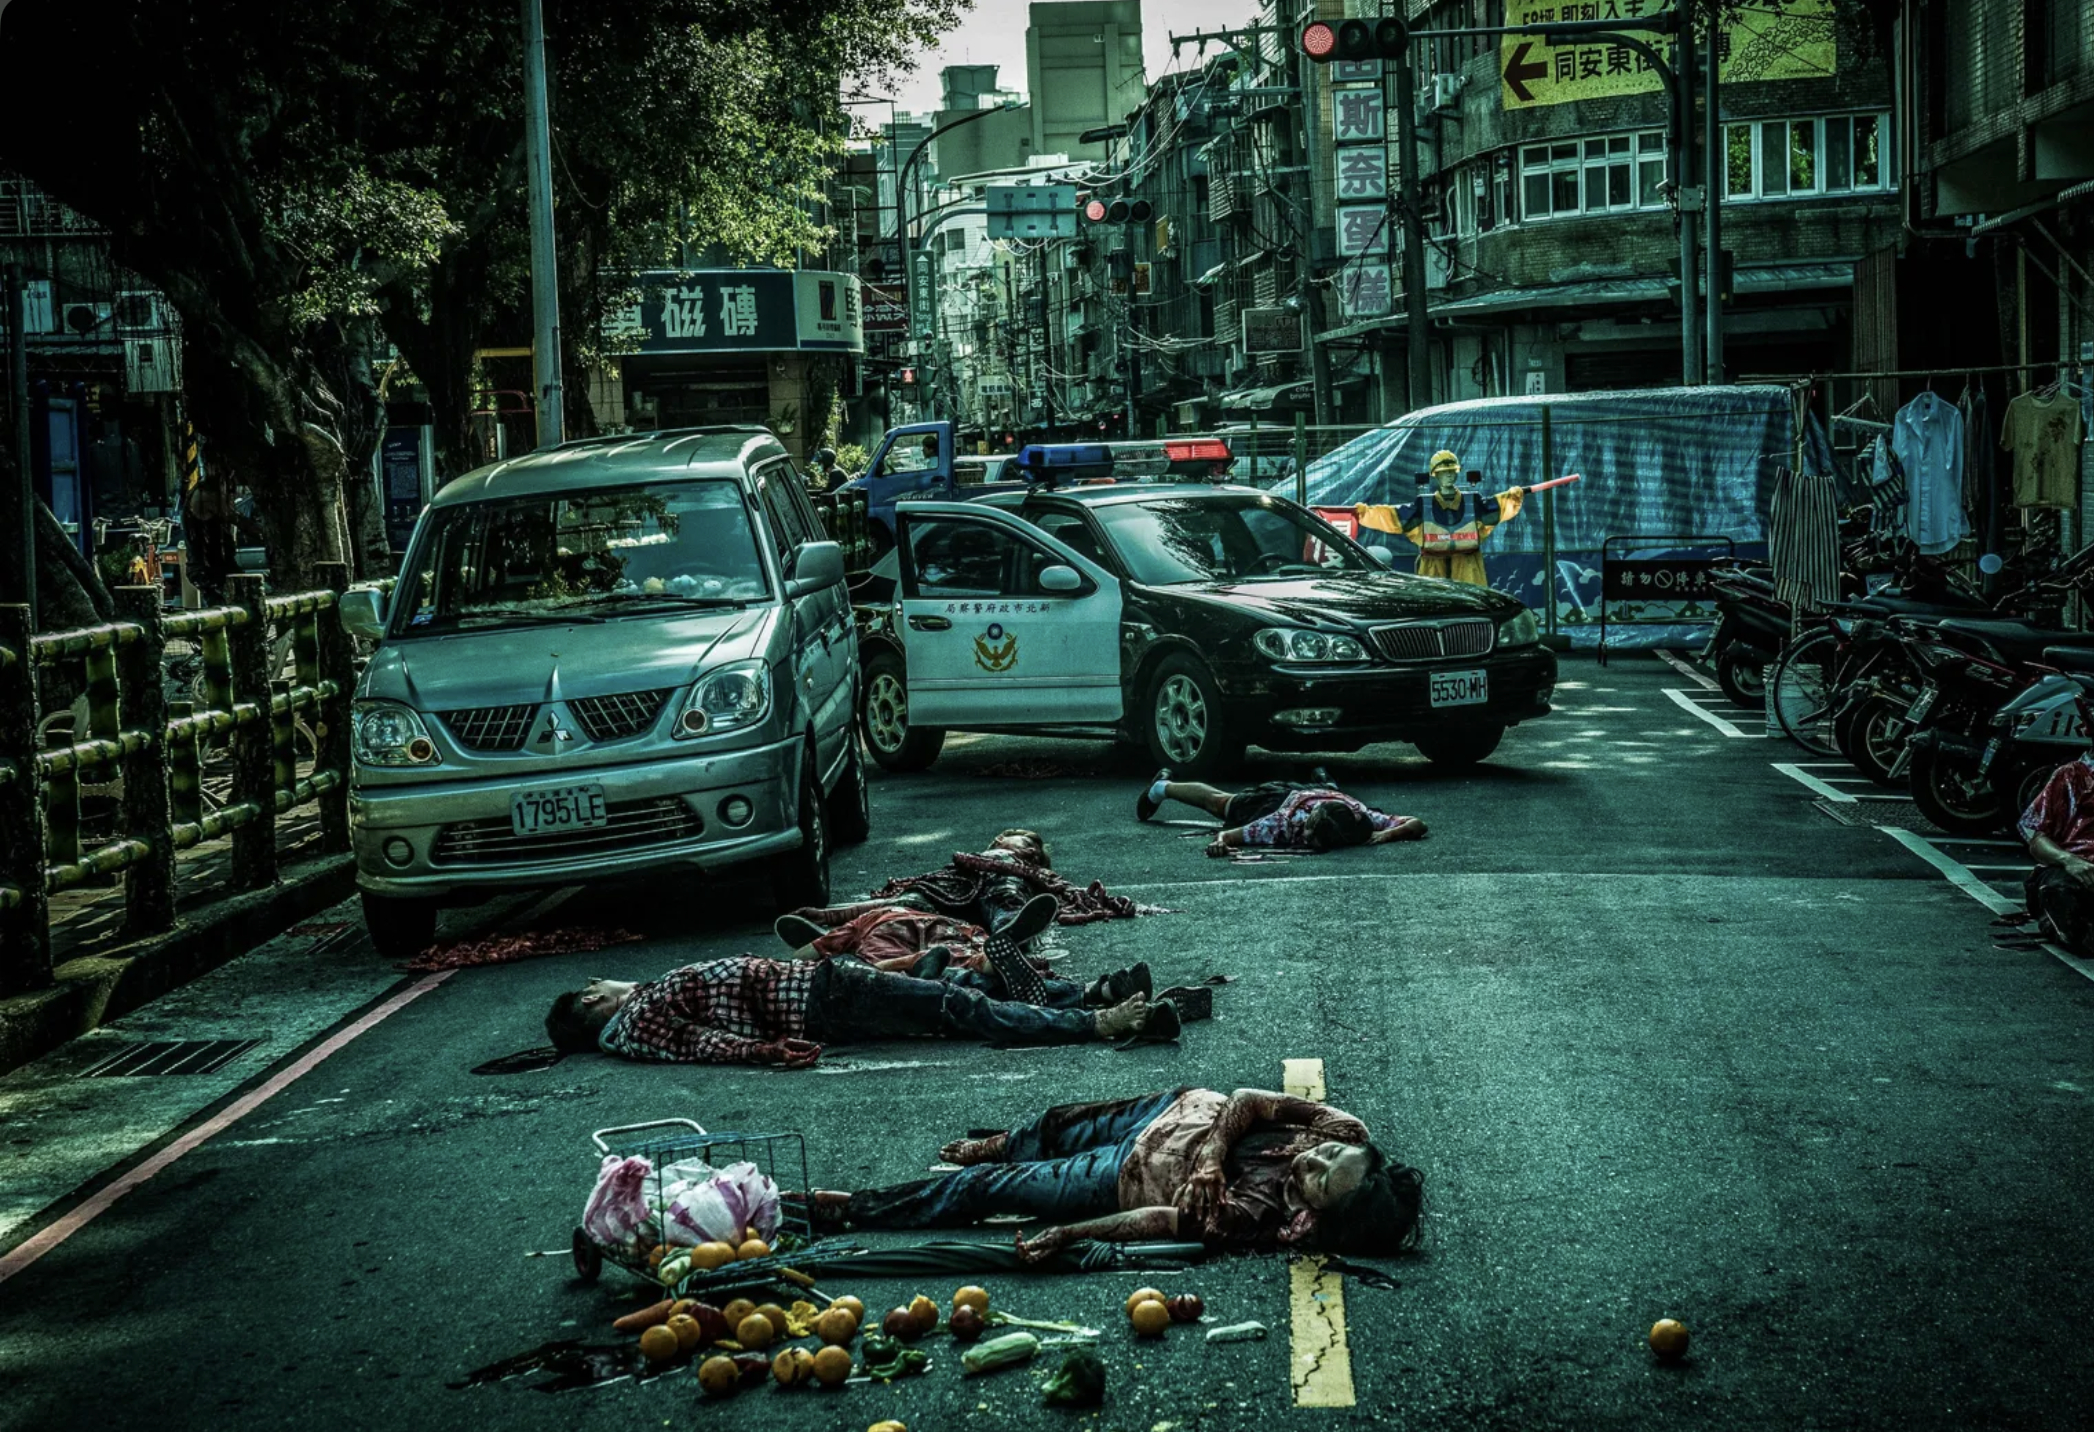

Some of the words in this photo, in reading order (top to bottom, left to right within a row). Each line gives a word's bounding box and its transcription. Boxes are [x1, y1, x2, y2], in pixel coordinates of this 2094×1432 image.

[917, 262, 930, 312] 同安東街
[915, 312, 932, 322] Tong
[1621, 571, 1652, 586] 請勿
[1676, 571, 1706, 586] 停車
[1432, 676, 1487, 702] 5530-MH
[516, 793, 605, 829] 1795-LE
